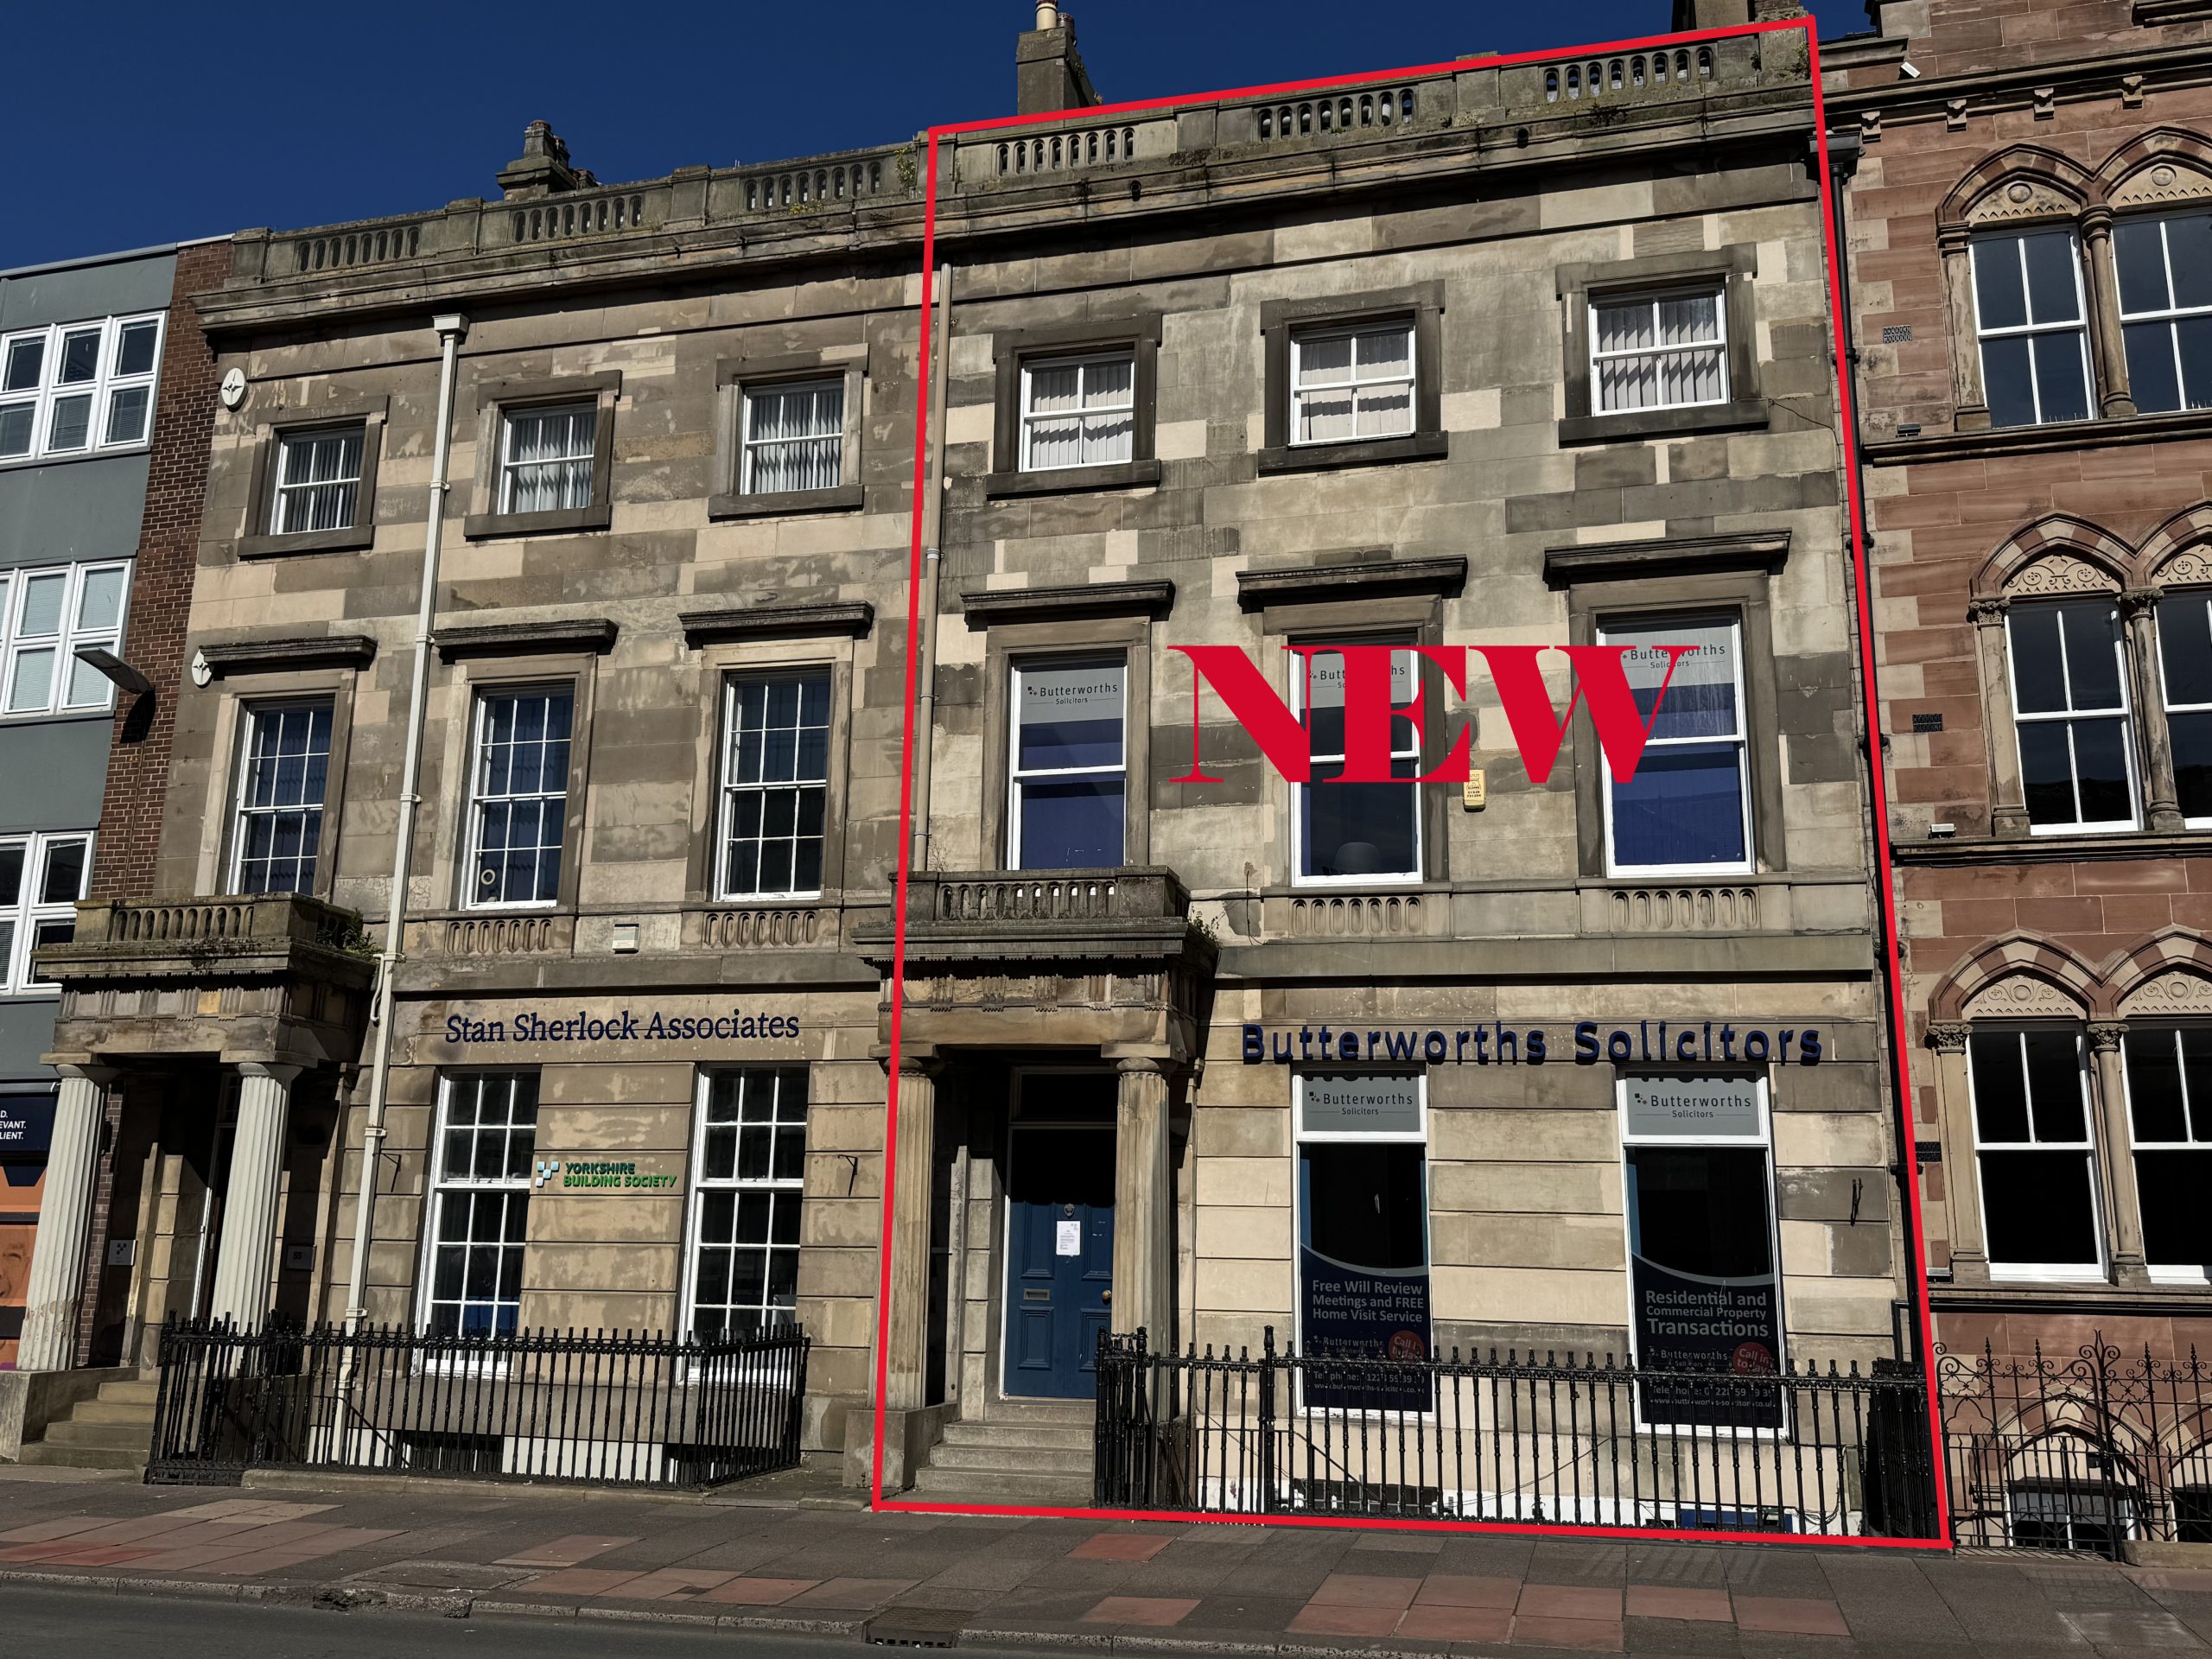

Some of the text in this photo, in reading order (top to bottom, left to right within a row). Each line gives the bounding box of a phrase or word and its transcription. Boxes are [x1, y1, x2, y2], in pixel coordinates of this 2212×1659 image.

[1631, 644, 1726, 660] Butteorths
[1320, 665, 1405, 680] Butths
[1040, 682, 1118, 697] Butterworths
[445, 1008, 800, 1043] Stan Sherlock Associates
[1242, 1020, 1822, 1065] Butterworths Solicitors
[1323, 1093, 1413, 1105] Butterworths
[1651, 1095, 1751, 1107] Butterworths
[566, 1162, 636, 1175] YORKSHIRE
[563, 1175, 677, 1188] BUILDING SOCIETY
[1313, 1280, 1423, 1295] Free Will Review
[1313, 1294, 1424, 1309] Meetings and FREE
[1646, 1290, 1766, 1306] Residential and
[1313, 1308, 1422, 1322] Home Visit Service
[1646, 1306, 1766, 1320] Commercial Property
[1647, 1318, 1769, 1337] Transactions
[1395, 1336, 1411, 1348] Call
[1739, 1348, 1769, 1364] Call in
[1653, 1385, 1702, 1395] Telehoe:
[1704, 1387, 1730, 1396] 022
[1735, 1388, 1746, 1396] 59
